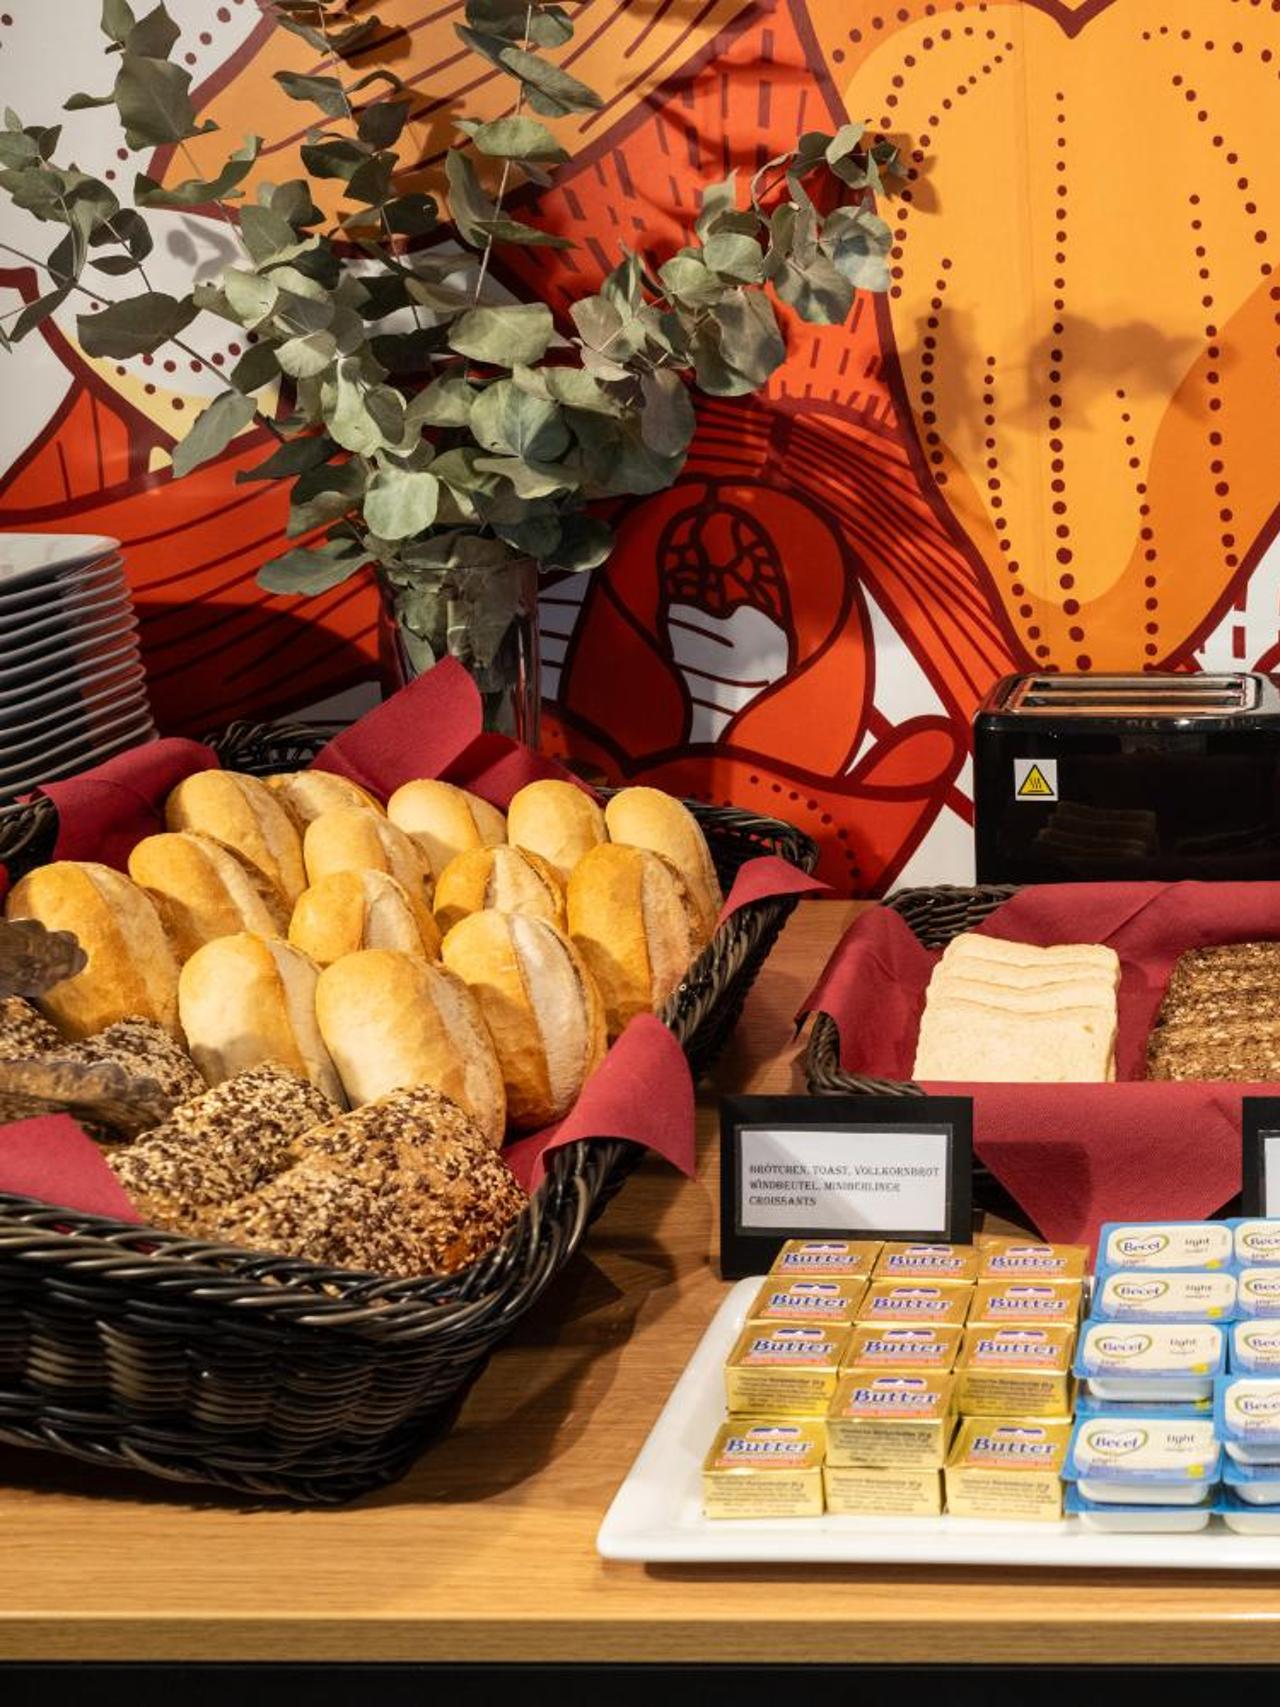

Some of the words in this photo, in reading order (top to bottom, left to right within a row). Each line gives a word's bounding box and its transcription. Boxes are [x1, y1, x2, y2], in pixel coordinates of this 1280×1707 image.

[854, 1165, 940, 1177] VOLLKORNBROT
[749, 1195, 817, 1206] CROISSANTS
[784, 1253, 859, 1265] Butter
[888, 1254, 966, 1268] Butter
[990, 1255, 1067, 1268] Butter
[771, 1294, 849, 1308] Butter
[872, 1296, 952, 1310] Butter
[989, 1296, 1067, 1310] Butter
[753, 1339, 833, 1354] Butter
[864, 1340, 948, 1354] Butter
[978, 1340, 1058, 1356] Butter
[852, 1388, 939, 1404] Butter
[726, 1438, 813, 1453] Butter
[972, 1437, 1057, 1454] Butter
